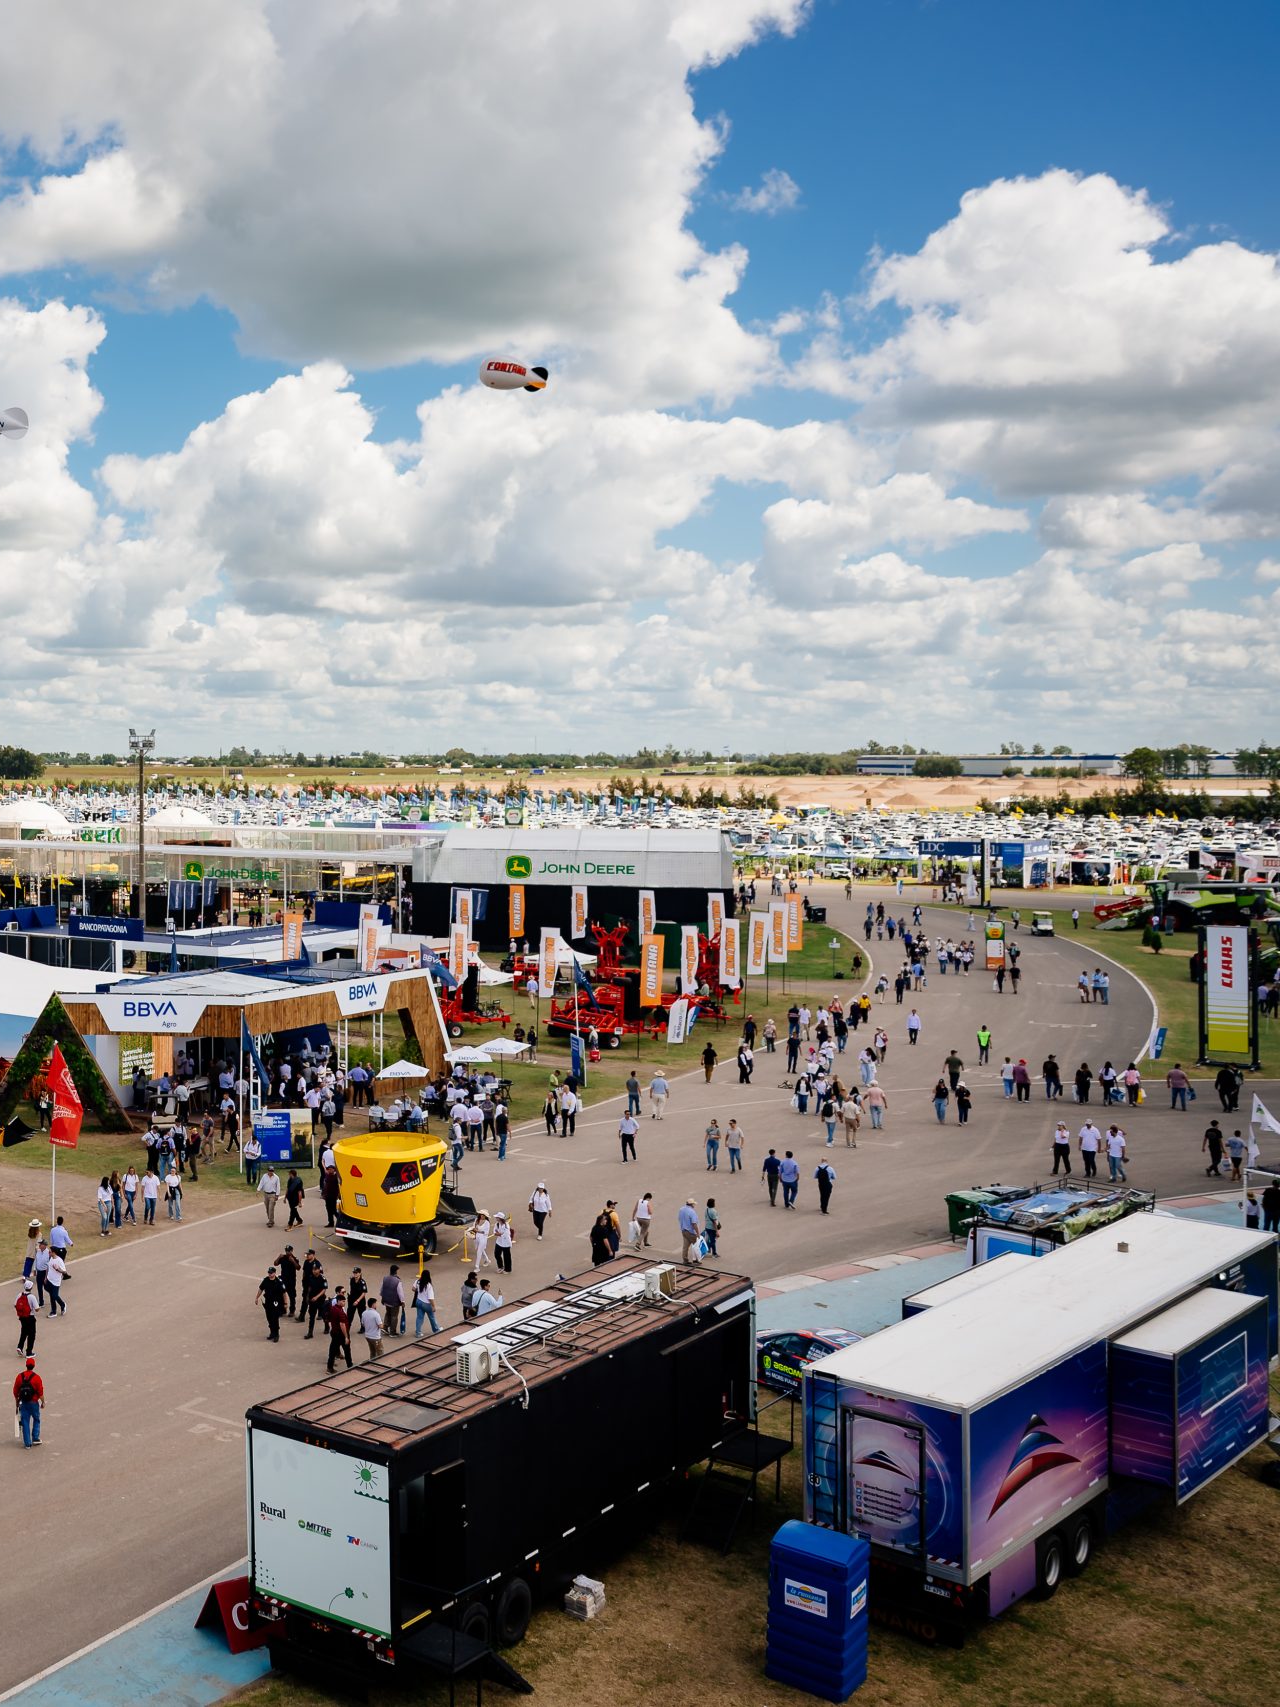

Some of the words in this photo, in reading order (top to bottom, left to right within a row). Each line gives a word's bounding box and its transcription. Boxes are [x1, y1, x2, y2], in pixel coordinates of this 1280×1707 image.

[921, 843, 945, 852] LDC
[972, 844, 997, 855] 181
[208, 867, 239, 879] JOHN
[240, 868, 280, 881] DEERE
[539, 861, 580, 874] JOHN
[583, 862, 636, 875] DEERE
[513, 892, 521, 931] FONTANA
[789, 901, 798, 943] FONTANA
[1221, 935, 1233, 989] CLAAS
[646, 944, 658, 998] FONTANA
[349, 981, 378, 1000] BBVA
[123, 1001, 178, 1017] BBVA
[162, 1020, 177, 1029] Agro
[389, 1178, 420, 1194] ASCANELLI
[260, 1501, 286, 1520] Rural
[306, 1520, 333, 1535] MITRE
[347, 1535, 361, 1546] TN
[231, 1600, 250, 1632] C
